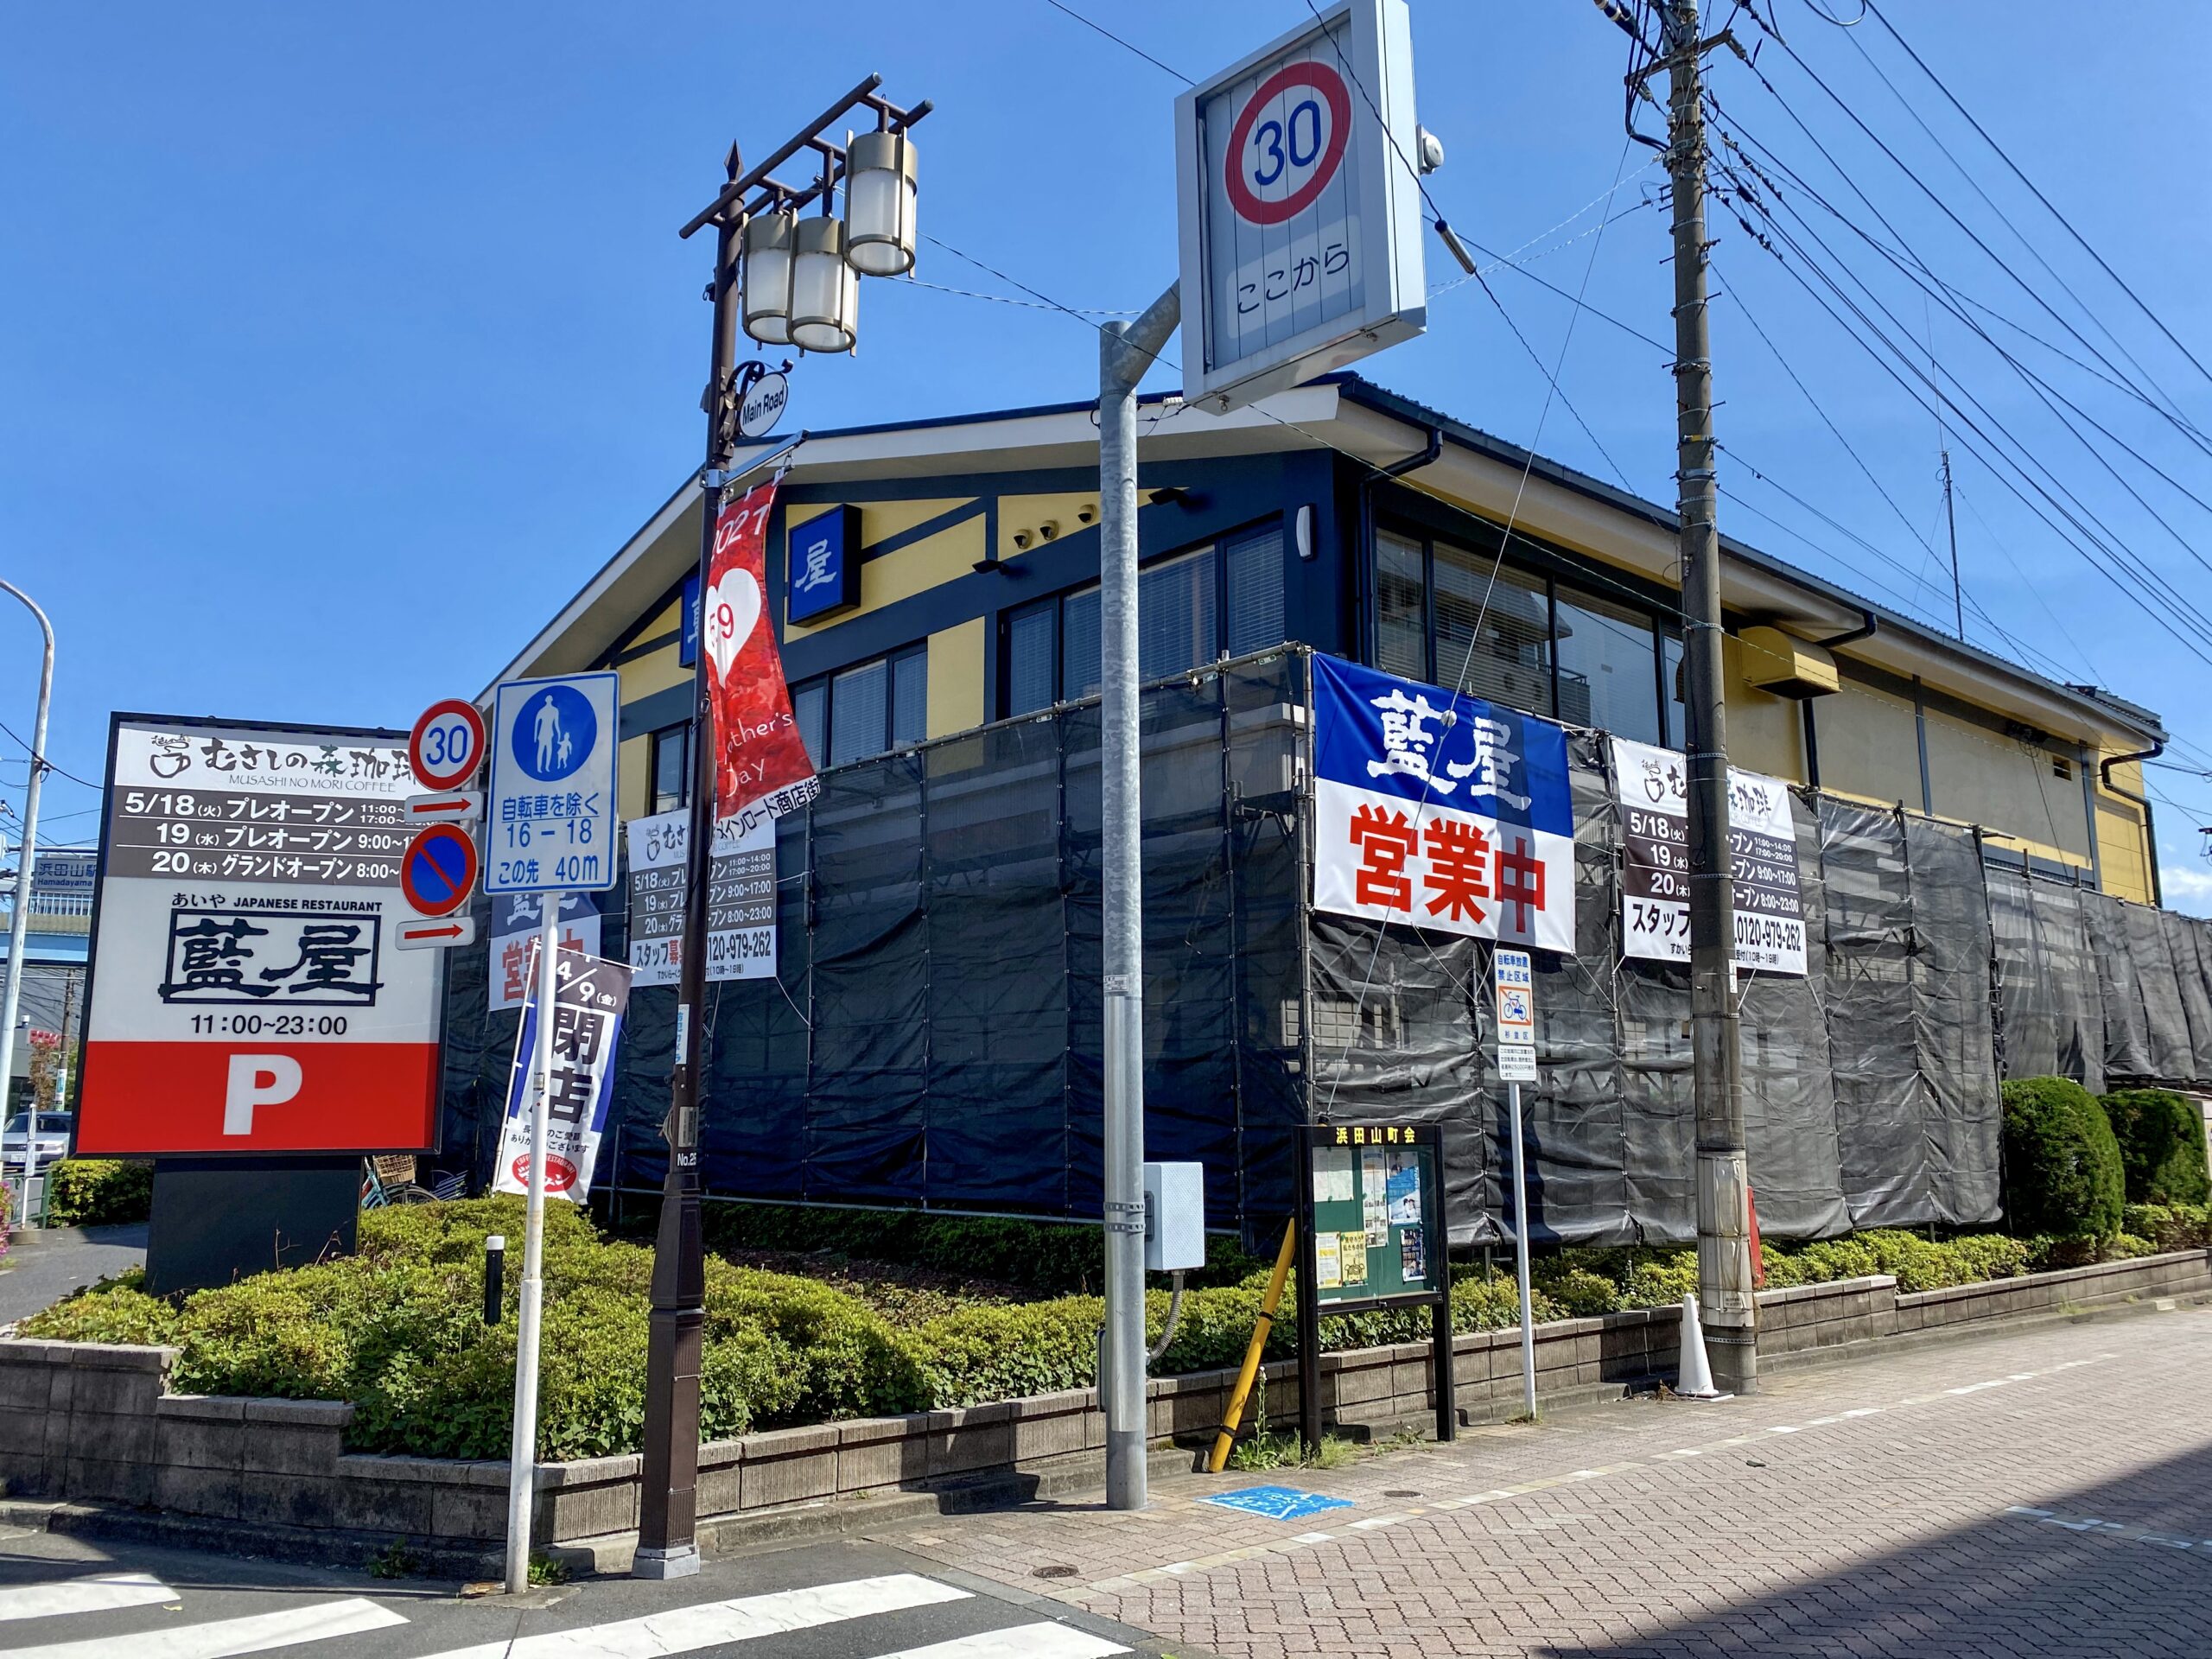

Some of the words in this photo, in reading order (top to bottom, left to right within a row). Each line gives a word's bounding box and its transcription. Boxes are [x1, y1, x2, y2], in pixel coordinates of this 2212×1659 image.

[1255, 99, 1321, 187] 30
[1237, 243, 1349, 315] ここから
[742, 399, 762, 426] Main
[763, 385, 785, 415] Road
[794, 537, 837, 594] 屋
[426, 725, 468, 766] 30
[1366, 689, 1532, 811] 藍屋
[229, 774, 287, 787] MUSASHI
[289, 777, 308, 789] NO
[311, 778, 343, 791] MORI
[346, 780, 396, 792] COFFEE
[124, 791, 196, 817] 5/18
[226, 798, 354, 823] プレオープン
[502, 791, 600, 820] 自転車を除く
[156, 823, 190, 844] 19
[195, 832, 219, 847] (水)
[225, 825, 353, 851] プレオープン
[358, 834, 416, 849] 9:00~1
[506, 823, 531, 848] 16
[567, 818, 592, 844] 18
[1630, 811, 1669, 839] 5/18
[151, 851, 190, 874] 20
[193, 861, 218, 875] (木)
[222, 854, 353, 880] グランドオープン
[729, 853, 771, 867] 11:00~14:00
[1650, 843, 1671, 867] 19
[499, 859, 539, 884] この先
[555, 855, 599, 881] 40m
[729, 862, 771, 876] 17:00~20:00
[1349, 803, 1546, 934] 営業中
[1757, 865, 1796, 887] 9:00~17:00
[37, 878, 92, 887] Hamadayama
[634, 872, 658, 891] 5/18
[728, 880, 772, 898] 9:00~17:00
[1650, 872, 1675, 895] 20
[171, 893, 226, 908] あいや
[233, 897, 298, 909] JAPANESE
[302, 899, 383, 912] RESTAURANT
[645, 894, 657, 912] 19
[1760, 893, 1799, 913] 8:00~23:00
[645, 917, 658, 934] 20
[728, 906, 772, 924] 8:00~23:00
[636, 939, 683, 967] スタッフ募
[1497, 955, 1529, 969] 自転車放置
[1497, 969, 1529, 983] 禁止区域
[223, 1054, 302, 1135] P
[1336, 1127, 1416, 1144] 浜田山町会
